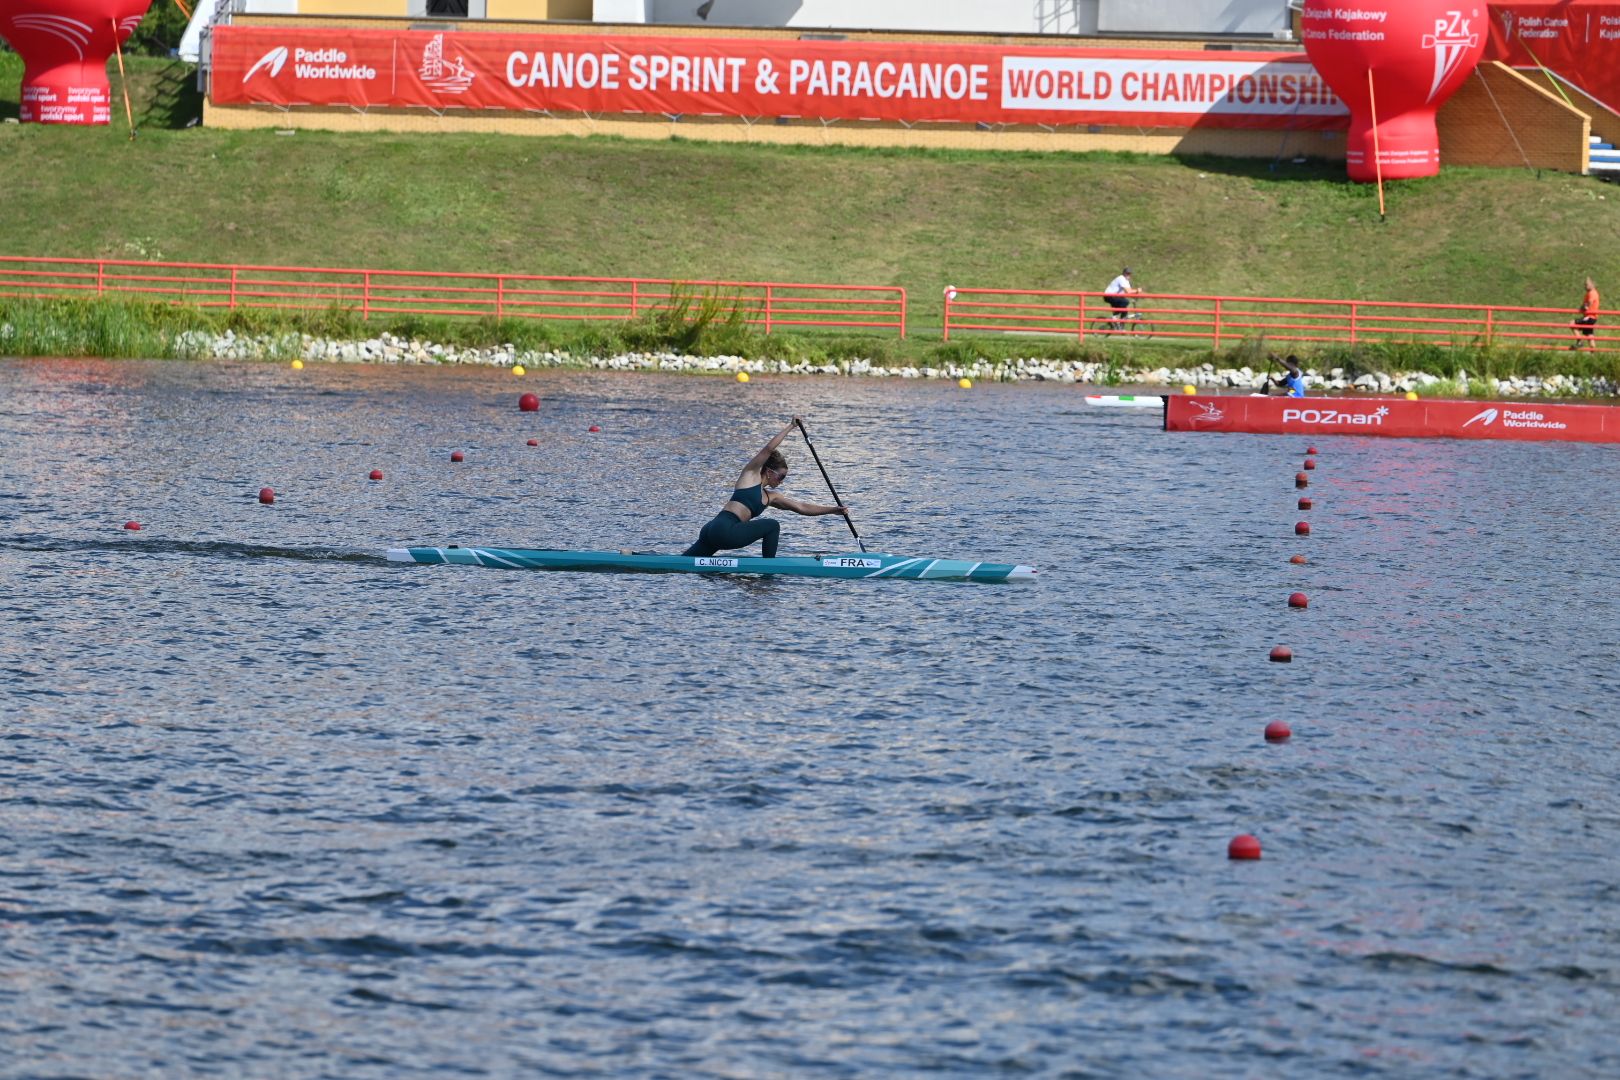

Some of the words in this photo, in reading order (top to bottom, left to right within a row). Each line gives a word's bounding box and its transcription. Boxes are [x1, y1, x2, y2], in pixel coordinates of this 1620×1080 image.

[1334, 8, 1387, 22] Kajakowy
[1435, 11, 1470, 37] PZK
[1328, 29, 1385, 41] Federation
[1518, 28, 1558, 38] Federation
[295, 48, 347, 63] Paddle
[295, 64, 376, 79] Worldwide
[506, 51, 619, 89] CANOE
[628, 55, 746, 93] SPRINT
[755, 58, 780, 94] &
[790, 59, 988, 100] PARACANOE
[1008, 69, 1113, 100] WORLD
[1503, 410, 1544, 420] Paddle
[1503, 419, 1566, 429] Worldwide
[841, 559, 865, 567] FRA
